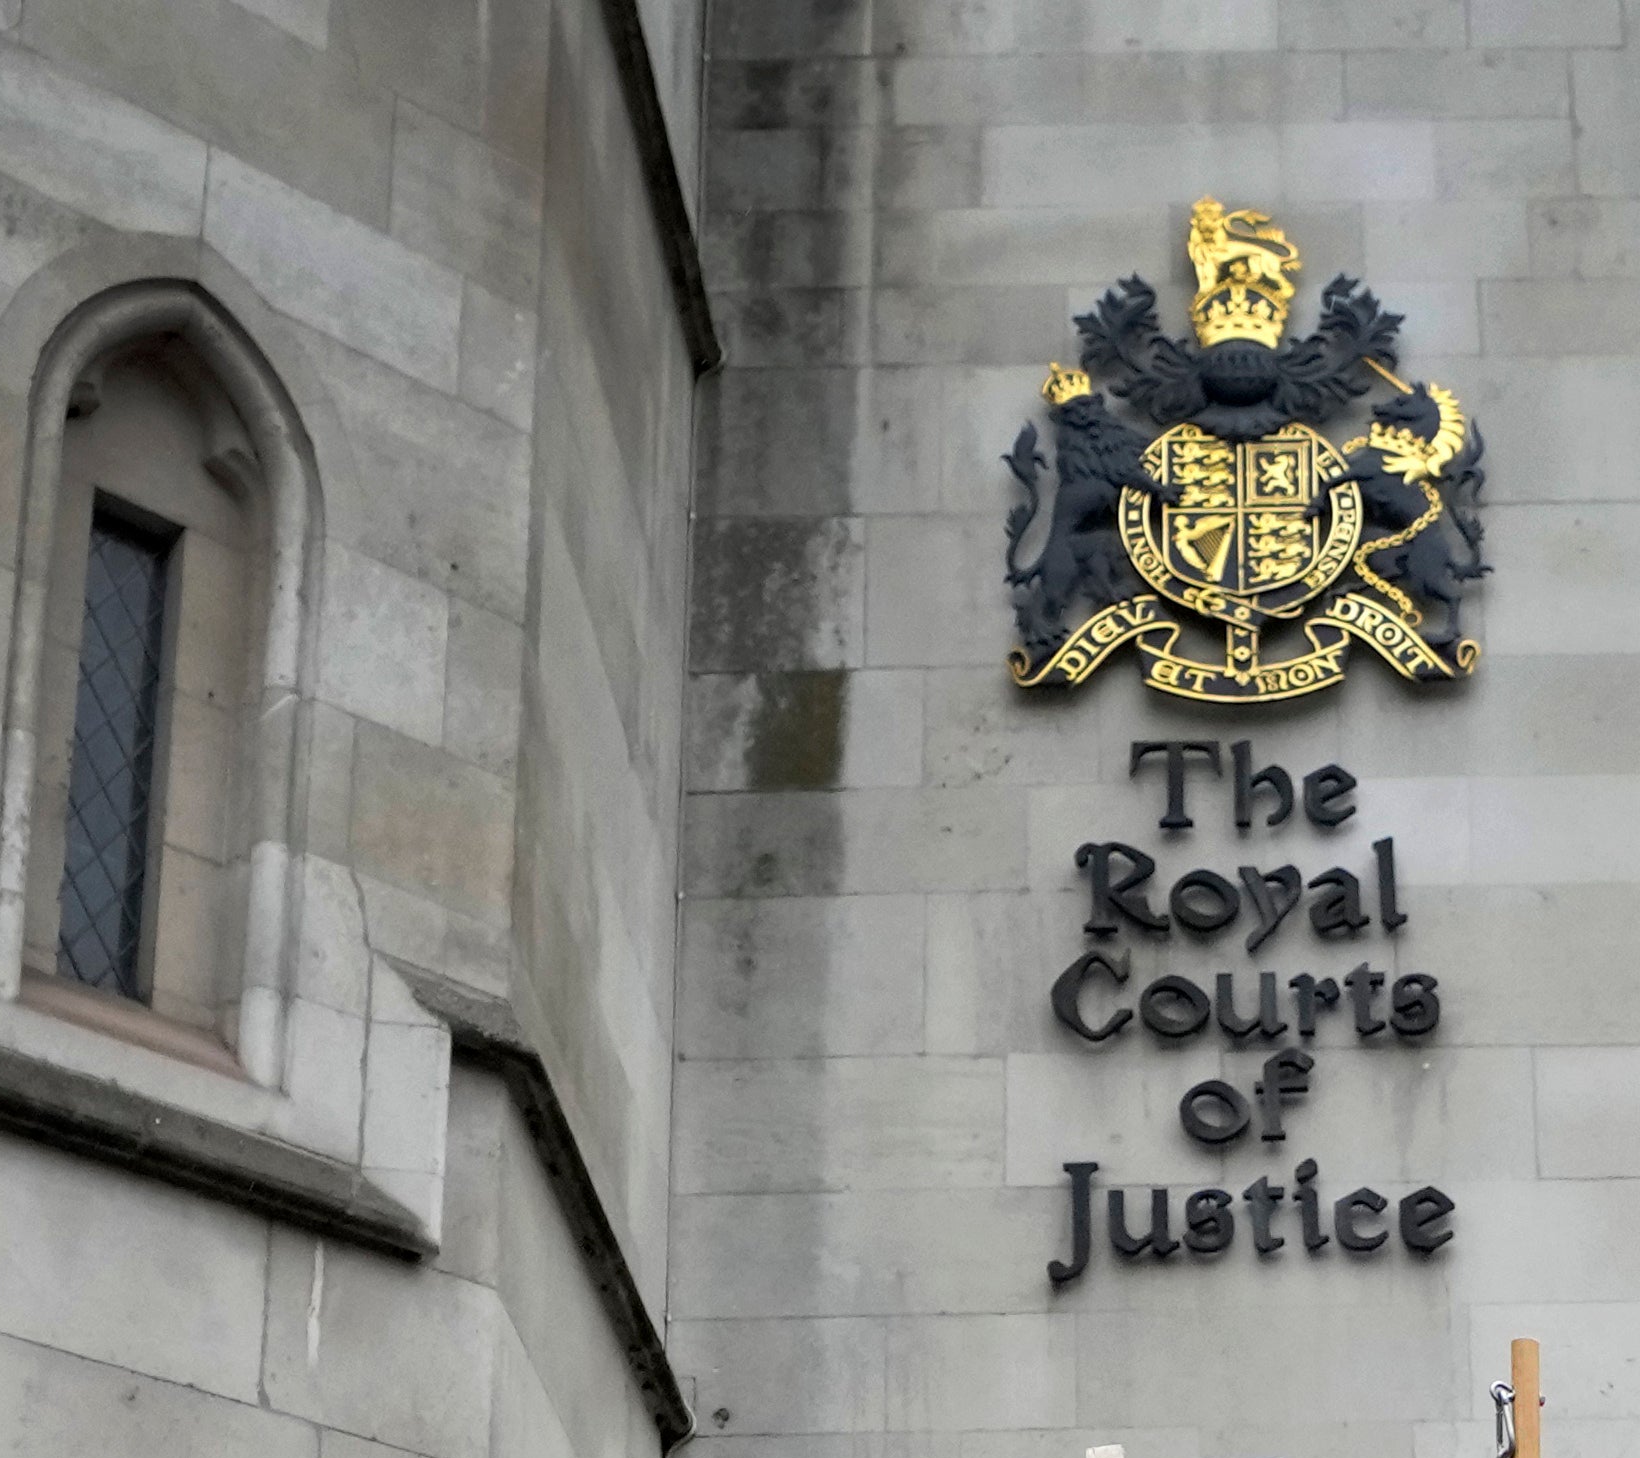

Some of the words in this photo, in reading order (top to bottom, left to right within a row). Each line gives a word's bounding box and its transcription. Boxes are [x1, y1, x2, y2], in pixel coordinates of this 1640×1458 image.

[1326, 598, 1434, 673] DROIT
[1128, 739, 1357, 831] The
[1076, 837, 1406, 951] Royal
[1050, 949, 1442, 1042] Courts
[1179, 1047, 1315, 1145] of
[1047, 1157, 1456, 1286] Justice
